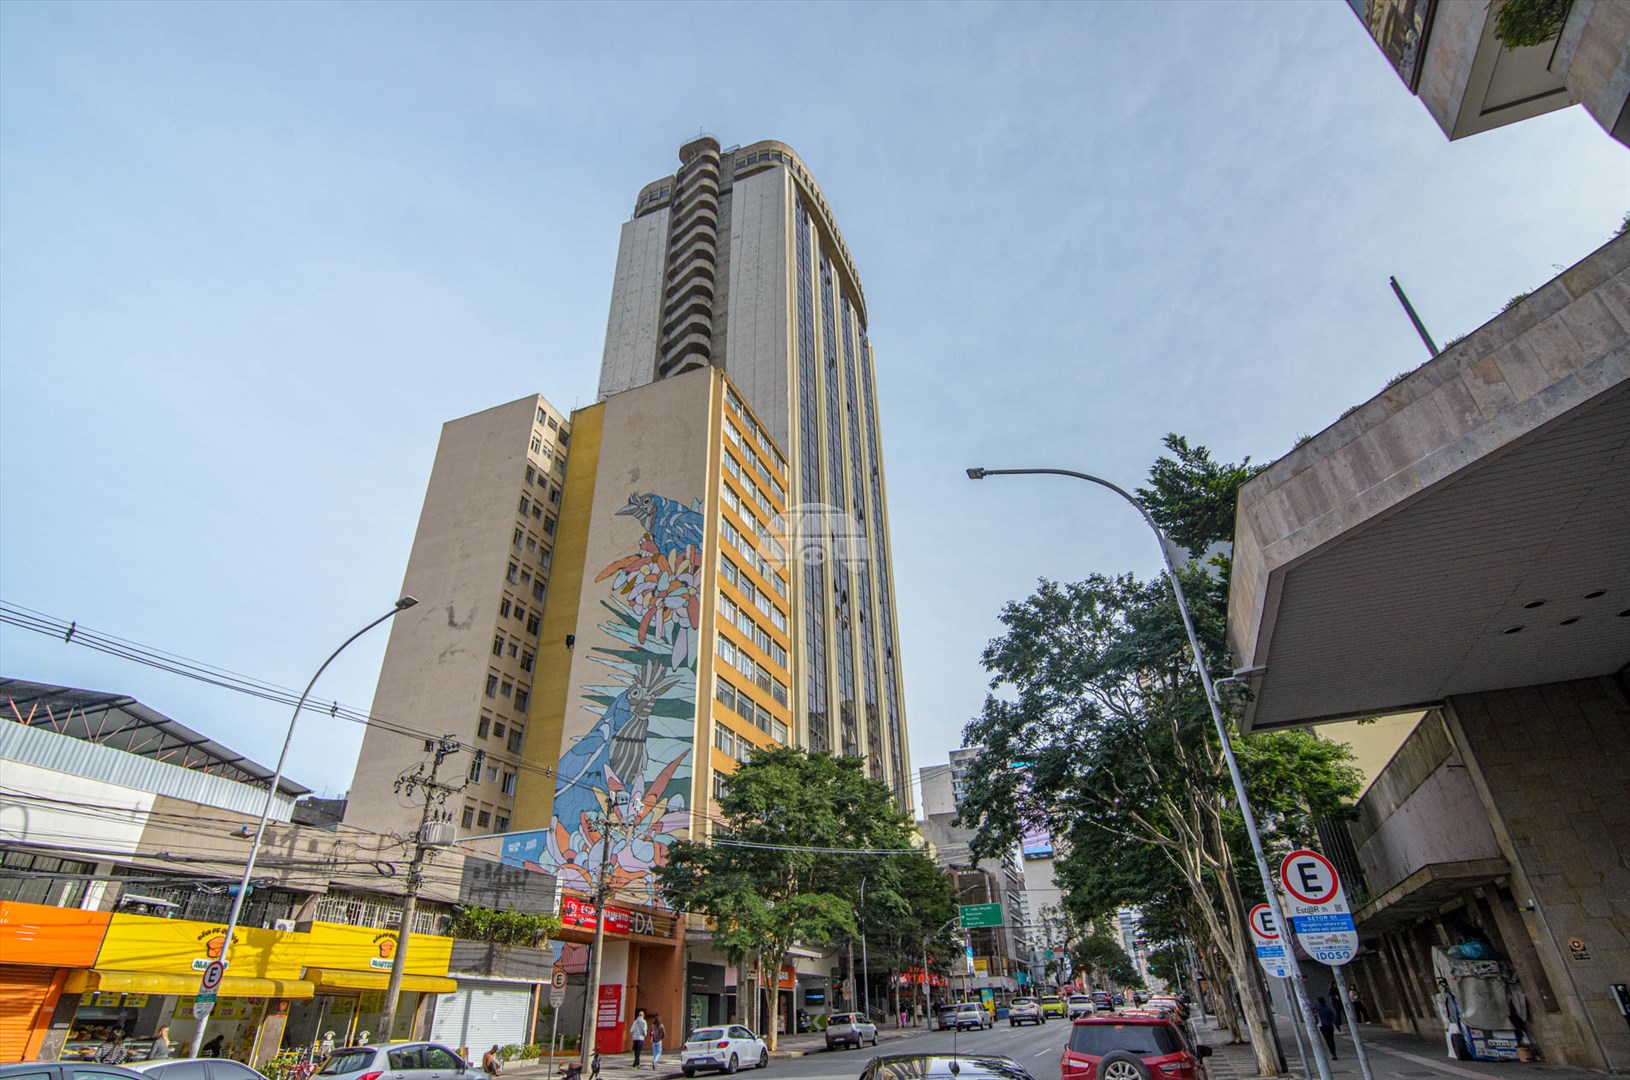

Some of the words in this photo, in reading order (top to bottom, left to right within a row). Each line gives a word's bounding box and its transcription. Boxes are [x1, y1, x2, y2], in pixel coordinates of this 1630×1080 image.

[1297, 862, 1323, 892] E
[1296, 906, 1319, 914] Est@R
[1260, 911, 1276, 932] E
[1316, 952, 1350, 960] IDOSO
[208, 967, 218, 982] E
[556, 974, 562, 984] E
